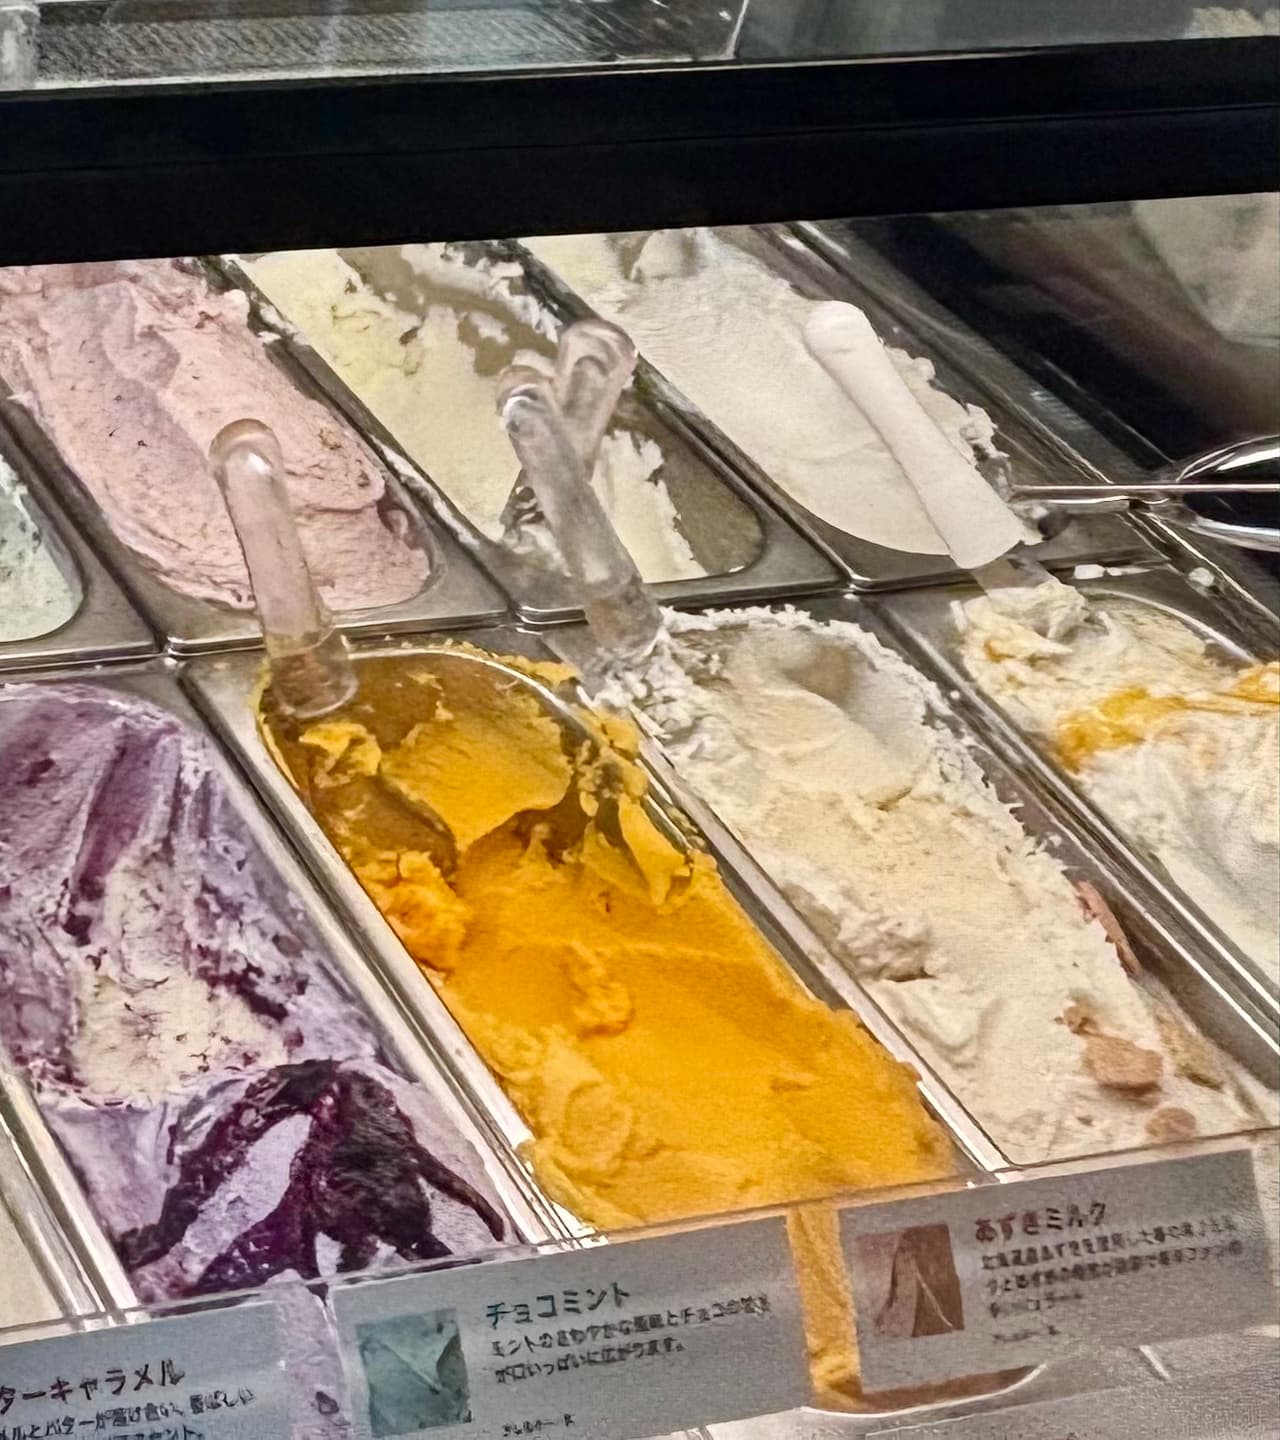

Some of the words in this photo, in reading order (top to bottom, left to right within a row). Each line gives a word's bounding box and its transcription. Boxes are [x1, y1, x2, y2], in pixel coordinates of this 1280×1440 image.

[485, 1281, 631, 1330] チョコミント
